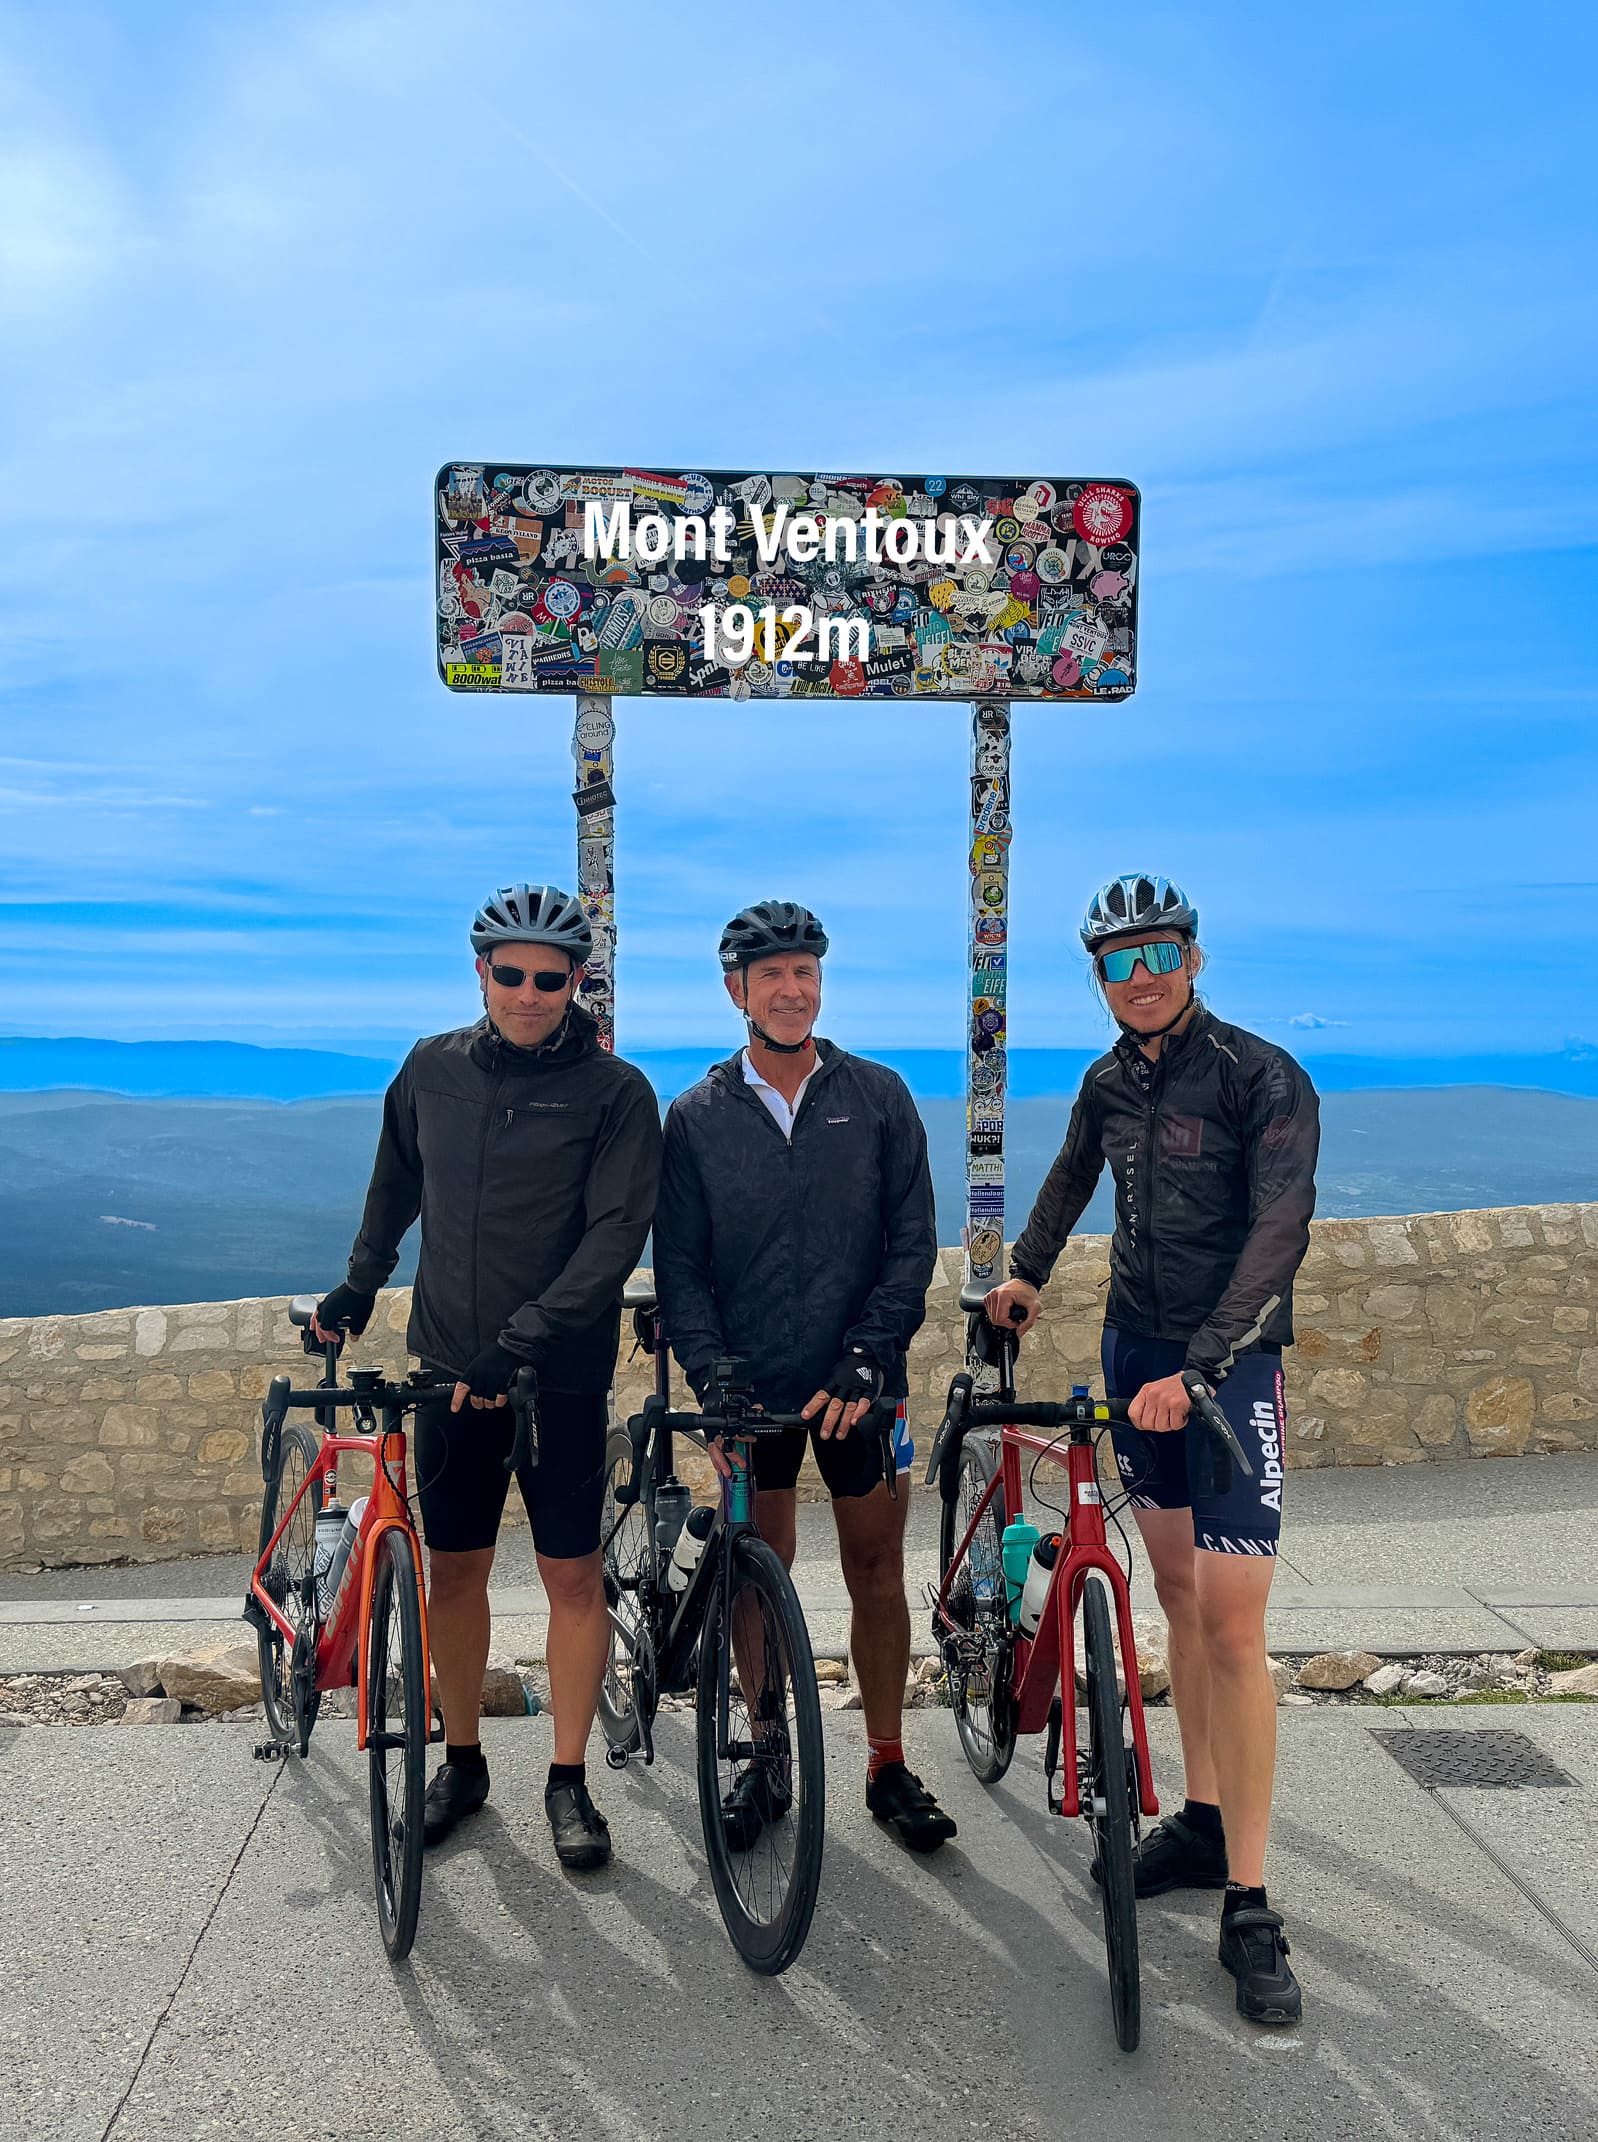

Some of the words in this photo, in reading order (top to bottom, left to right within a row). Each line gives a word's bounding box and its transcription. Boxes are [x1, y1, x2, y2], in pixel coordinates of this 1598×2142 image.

[928, 480, 943, 492] 22
[1096, 487, 1125, 502] SHARKS
[1089, 532, 1121, 545] ROWING
[466, 556, 488, 565] pizza
[490, 552, 514, 561] basta
[861, 584, 897, 598] RIXHEIM
[1070, 633, 1097, 653] SSVC
[810, 664, 827, 674] LIKE
[866, 657, 907, 676] Mulet
[452, 674, 502, 685] 8000wat
[542, 679, 564, 687] pizza
[577, 721, 611, 732] CYCLING
[580, 730, 609, 739] around
[976, 791, 997, 832] bredene
[1249, 1401, 1284, 1513] Alpecin
